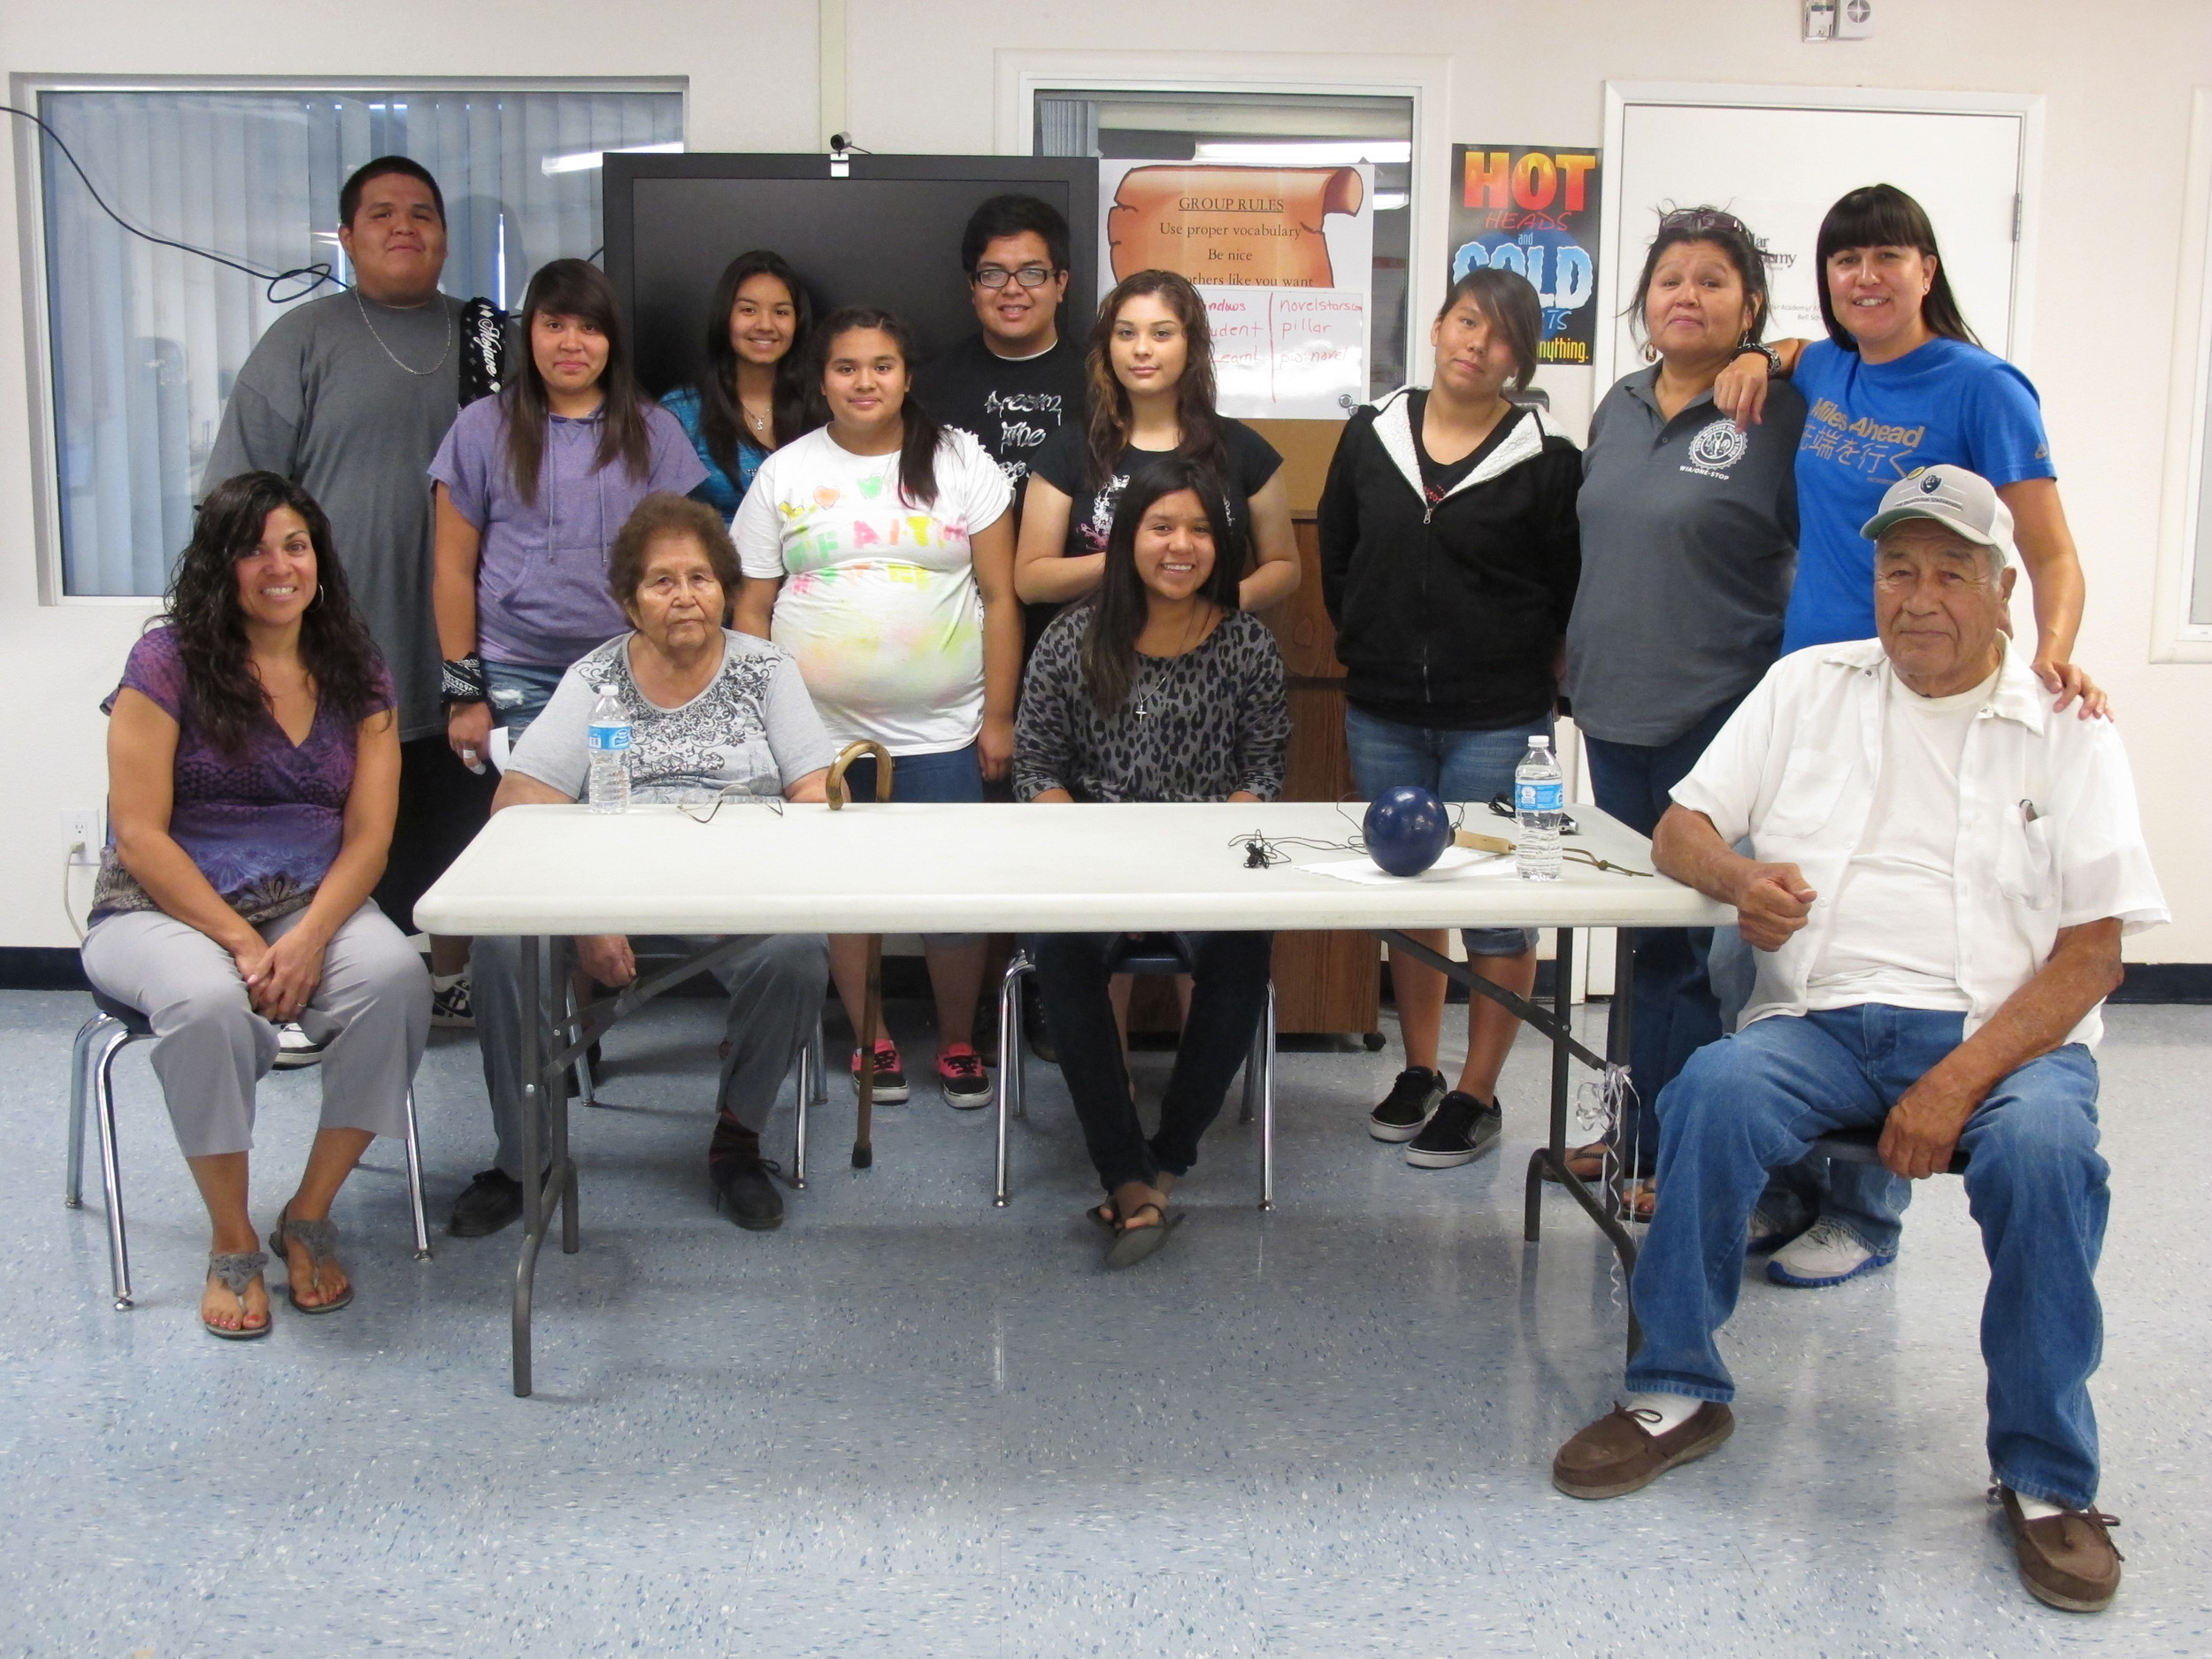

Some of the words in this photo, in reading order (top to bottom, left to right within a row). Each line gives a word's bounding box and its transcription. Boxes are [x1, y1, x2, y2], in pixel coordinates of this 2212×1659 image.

[1463, 151, 1596, 211] HOT
[1179, 197, 1233, 211] GROUP
[1238, 198, 1284, 211] RULES
[1485, 210, 1572, 231] HEADS
[1160, 222, 1183, 234] Use
[1187, 225, 1228, 237] proper
[1233, 224, 1302, 240] vocabulary
[1517, 233, 1533, 246] and
[1208, 249, 1224, 260] Be
[1228, 250, 1253, 261] nice
[1186, 273, 1224, 286] others
[1228, 273, 1251, 286] like
[1255, 278, 1278, 287] you
[1283, 279, 1313, 288] want
[1282, 318, 1333, 340] pillar
[1537, 338, 1589, 363] nything.
[1810, 397, 1849, 432] Miles
[1848, 417, 1926, 448] Ahead
[1679, 465, 1730, 480] WIA/ONE-STOP
